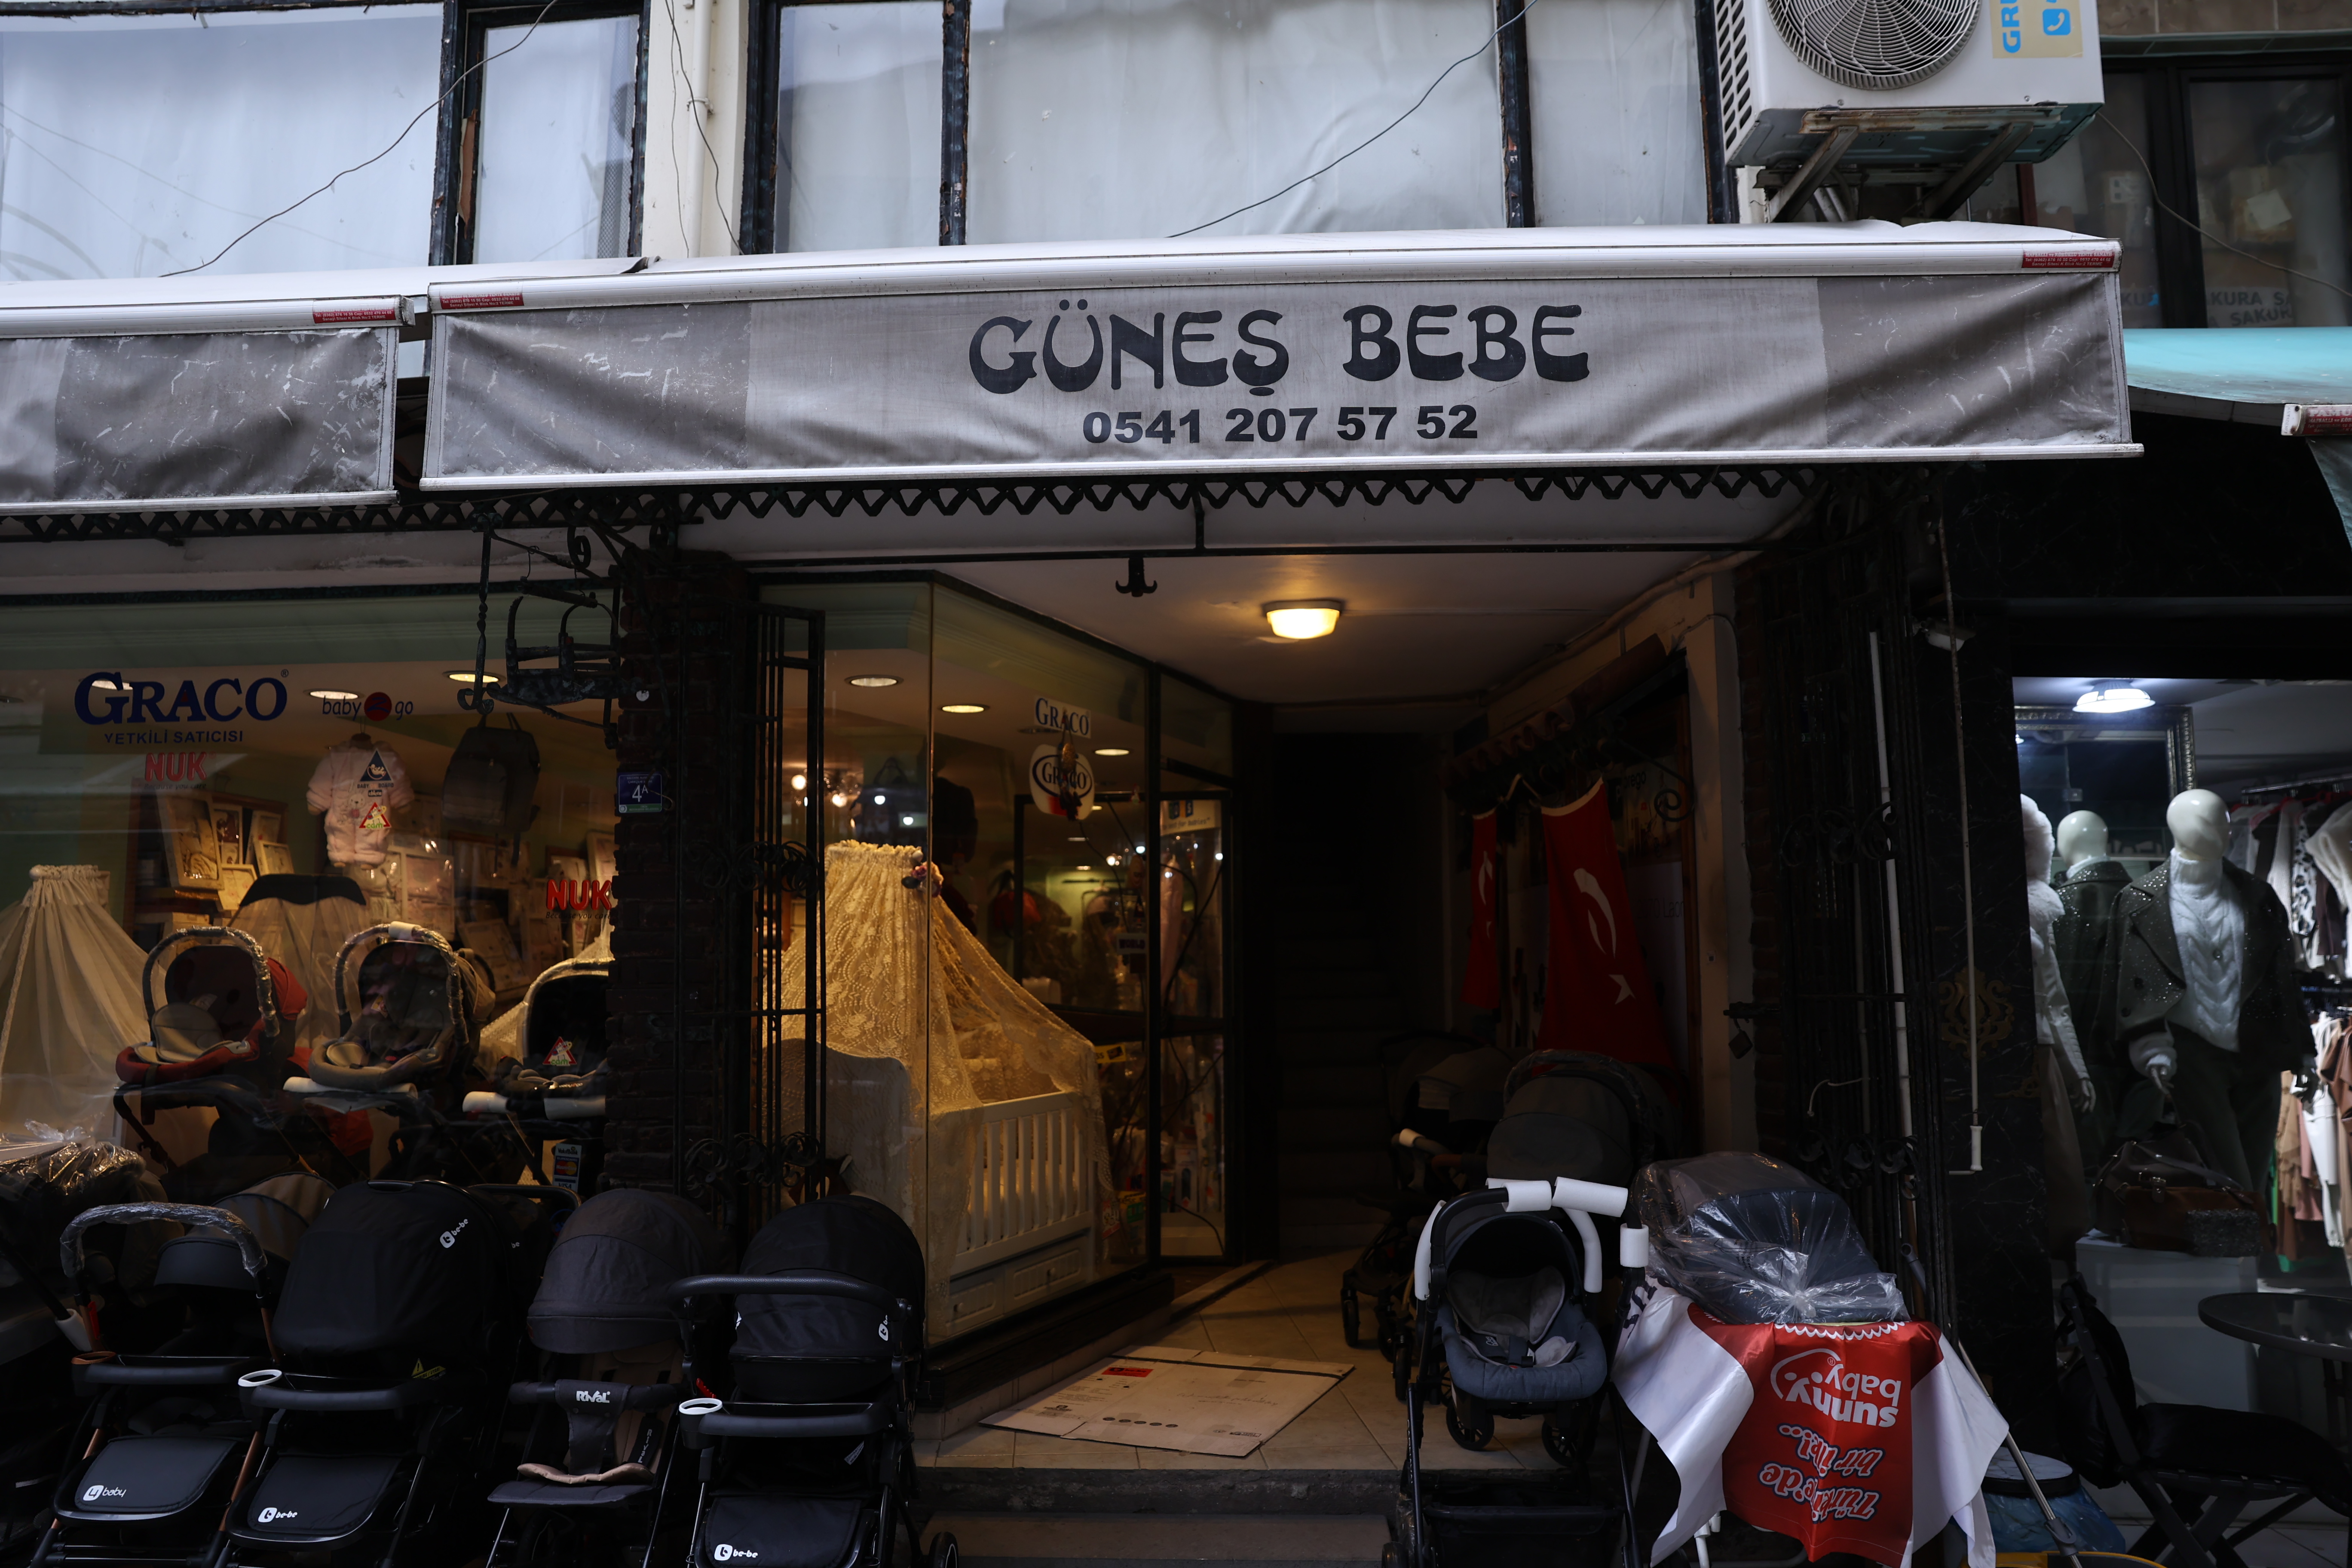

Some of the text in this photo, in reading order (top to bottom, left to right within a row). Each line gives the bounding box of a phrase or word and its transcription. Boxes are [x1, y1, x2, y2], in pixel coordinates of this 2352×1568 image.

[2001, 0, 2021, 53] GR
[969, 299, 1590, 397] GÜNEŞ BEBE
[1083, 404, 1478, 444] 0541 207 57 52
[74, 671, 287, 725] GRACO
[322, 695, 361, 721] baby
[395, 701, 413, 721] go
[104, 729, 243, 744] YETKİLİ SATICISI
[144, 751, 207, 781] NUK
[546, 879, 612, 910] NUK
[1785, 1377, 1899, 1427] sunny
[1824, 1363, 1902, 1407] baby
[732, 1549, 758, 1558] be-be
